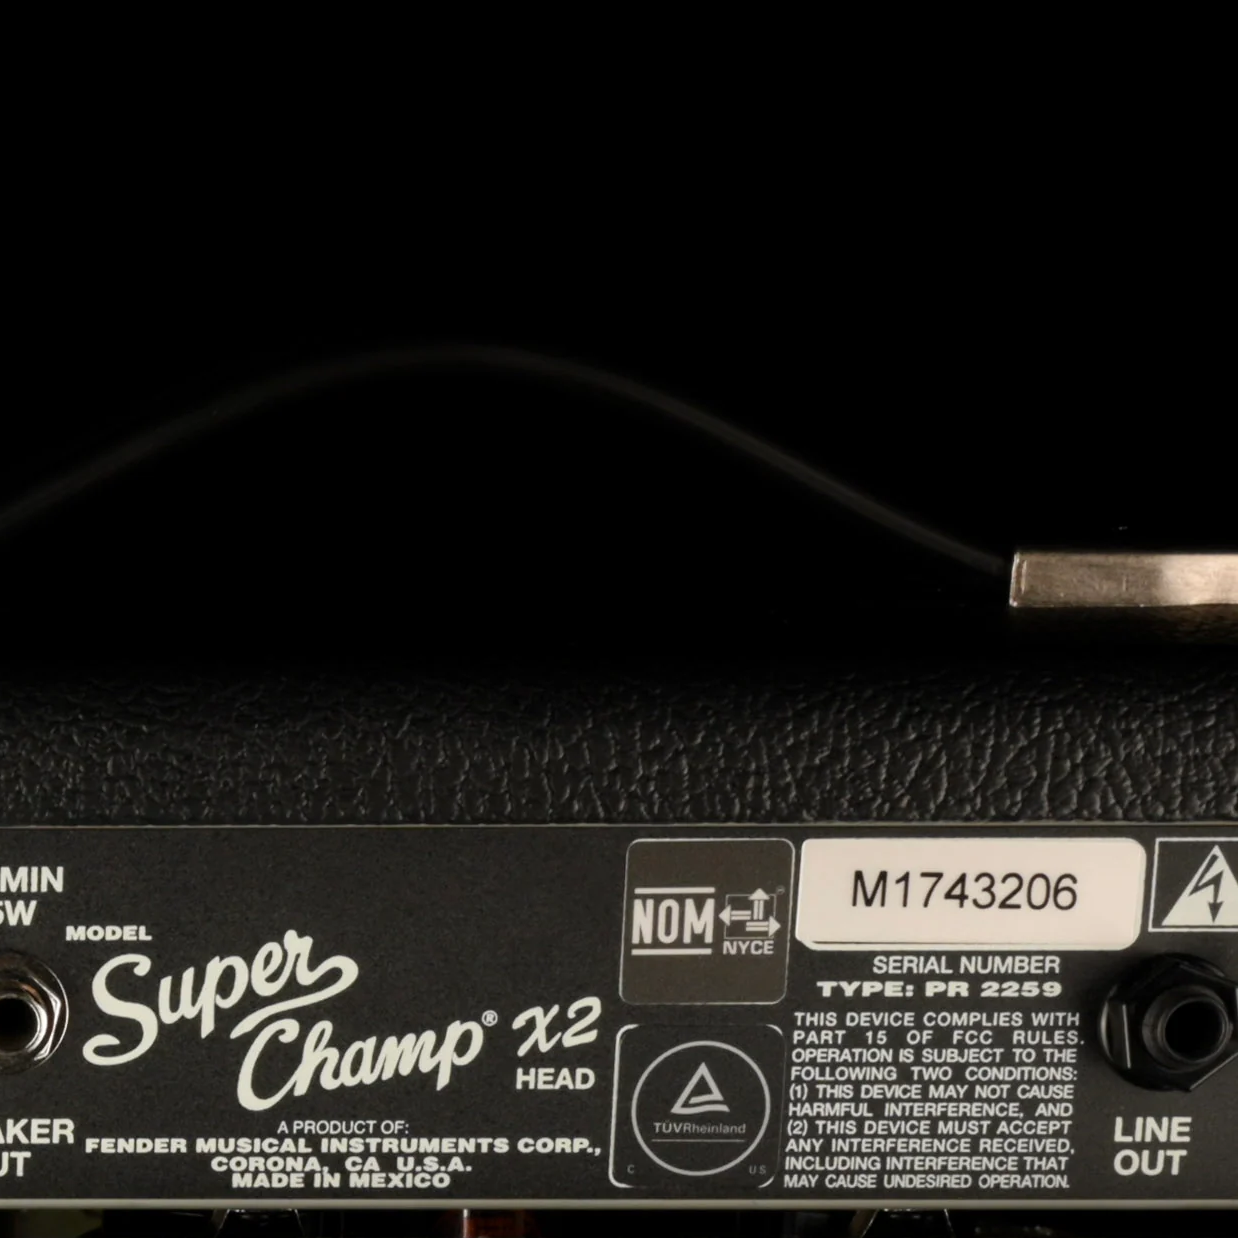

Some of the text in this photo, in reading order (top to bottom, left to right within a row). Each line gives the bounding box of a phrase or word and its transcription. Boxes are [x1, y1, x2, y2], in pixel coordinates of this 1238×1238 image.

[0, 866, 63, 892] MIN
[852, 870, 1077, 910] M1743206
[632, 899, 714, 944] NOM
[66, 925, 152, 941] MODEL
[723, 940, 774, 954] NYCE
[873, 956, 1060, 974] SERIAL NUMBER
[817, 981, 1061, 997] TYPE: PR 2259
[82, 929, 360, 1066] Super
[794, 1012, 1079, 1026] THIS DEVICE COMPLIES WITH
[793, 1030, 1083, 1045] PART 15 OF FCC RULES.
[792, 1048, 1077, 1063] OPERATION IS SUBJECT TO THE
[516, 1068, 595, 1089] HEAD
[791, 1066, 1077, 1081] FOLLOWING TWO CONDITIONS:
[790, 1083, 1074, 1100] (1) THIS DEVICE MAY NOT CAUSE
[789, 1102, 1073, 1118] HARMFUL INTERFERENCE, AND
[277, 1120, 408, 1134] A PRODUCT OF:
[787, 1120, 1072, 1136] (2) THIS DEVICE MUST ACCEPT
[1114, 1117, 1191, 1142] LINE
[86, 1138, 601, 1156] FENDER MUSICAL INSTRUMENTS CORP.,
[786, 1138, 1074, 1154] ANY INTERFERENCE RECEIVED,
[211, 1156, 472, 1174] CORONA, CA U.S.A.
[785, 1156, 1068, 1170] INCLUDING INTERFERENCE THAT
[1114, 1149, 1187, 1175] OUT
[232, 1172, 450, 1188] MADE IN MEXICO
[784, 1174, 1069, 1188] MAY CAUSE UNDESIRED OPERATION.
